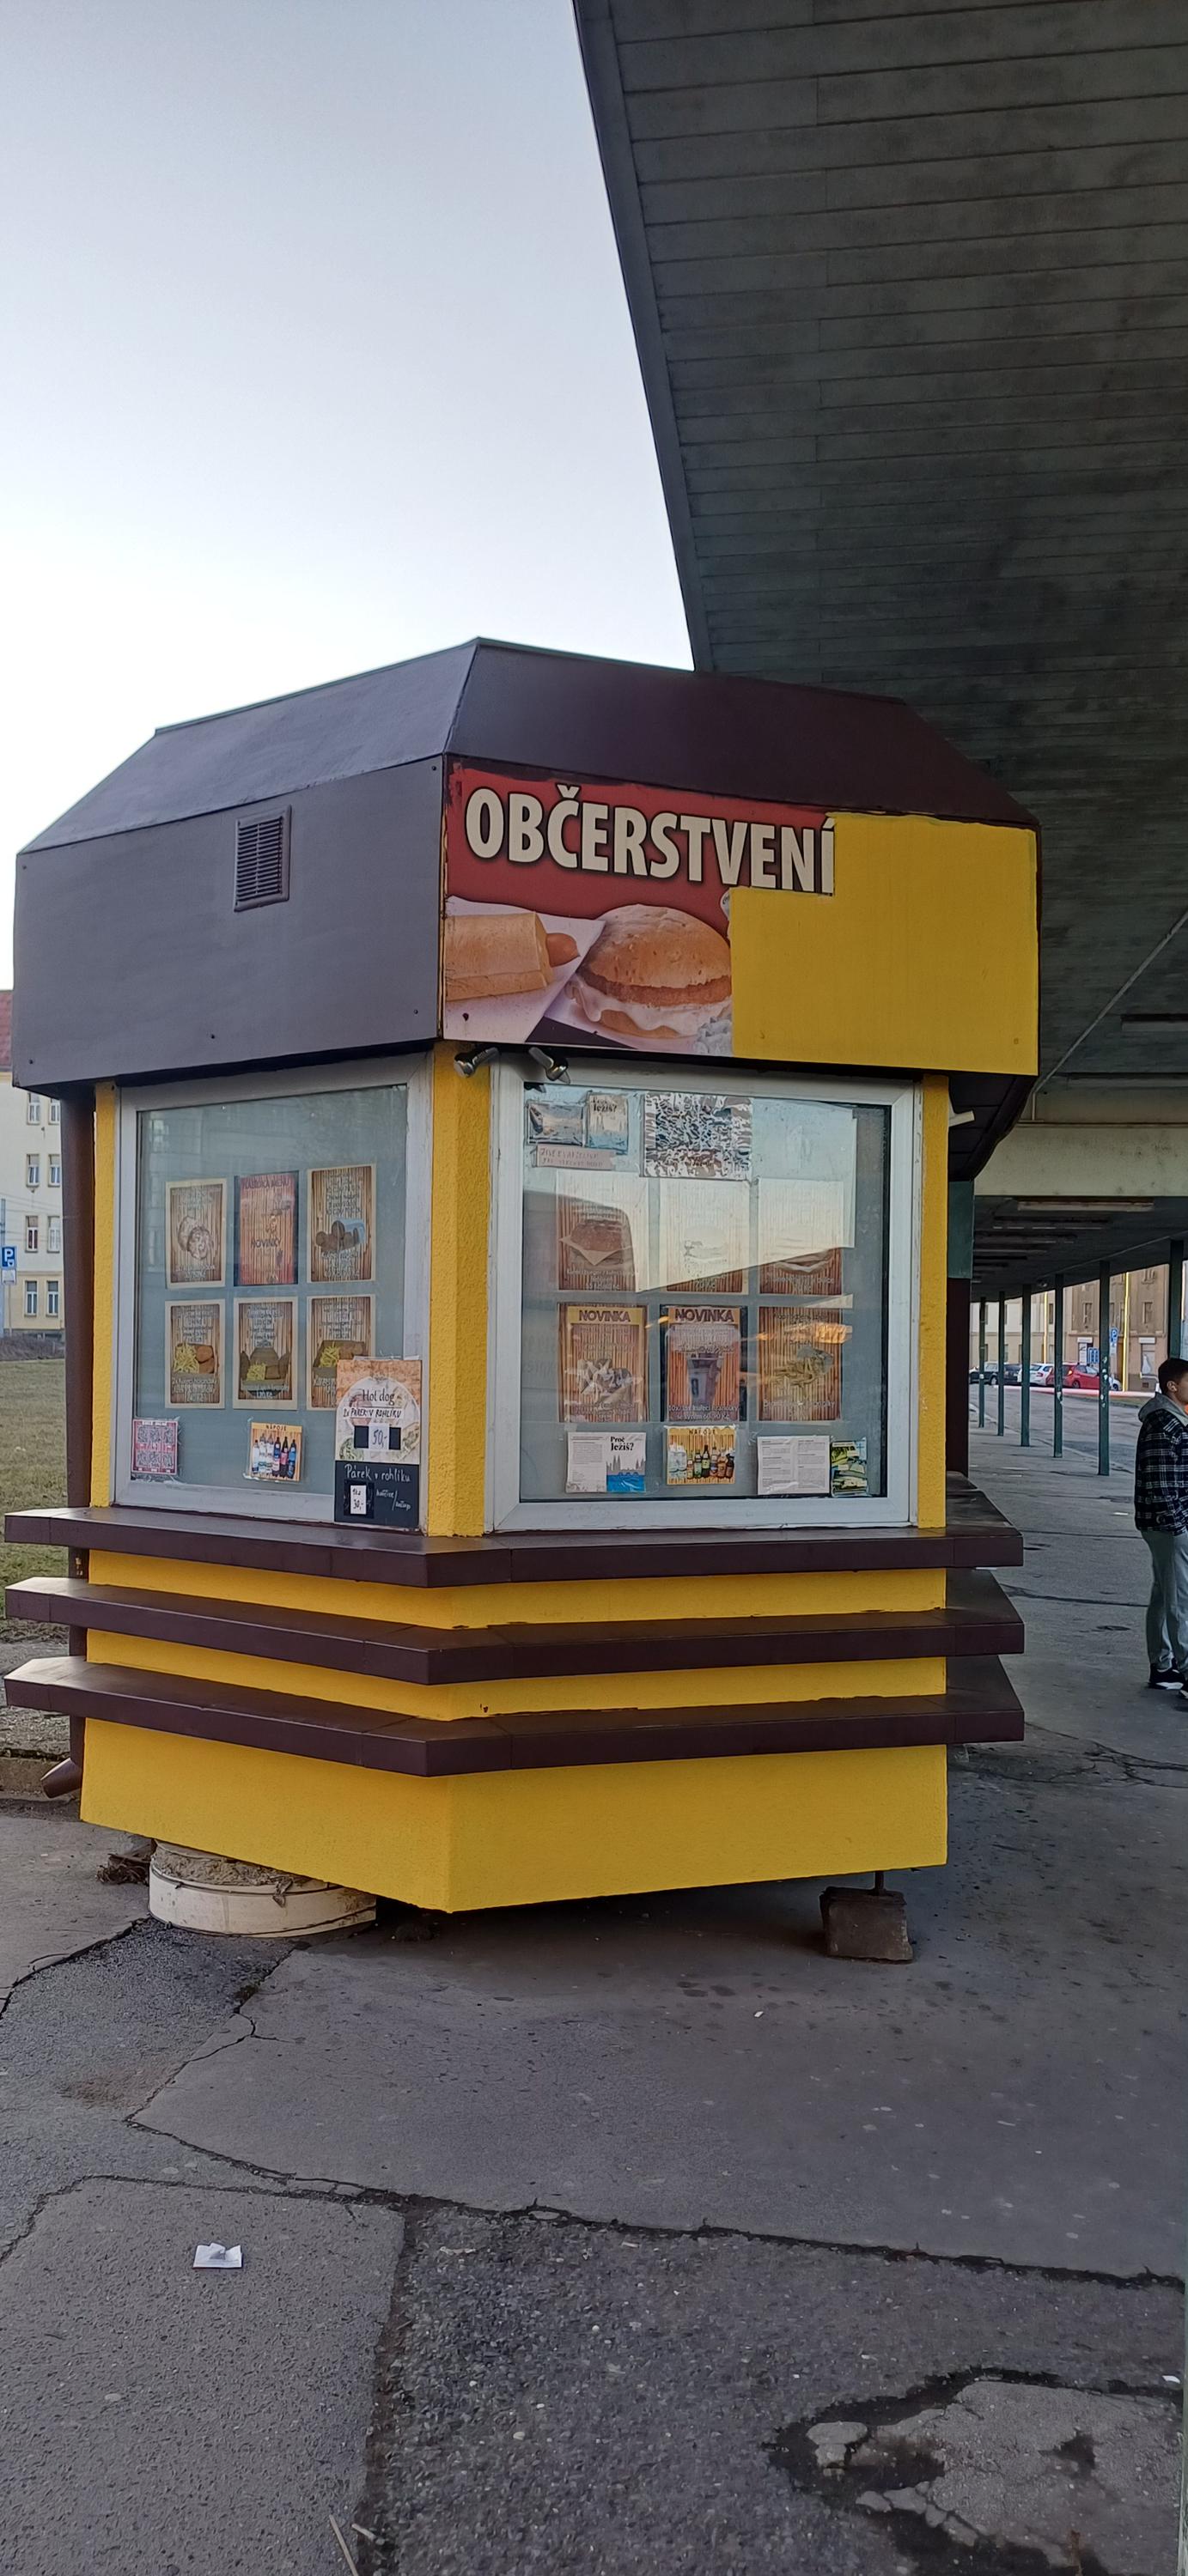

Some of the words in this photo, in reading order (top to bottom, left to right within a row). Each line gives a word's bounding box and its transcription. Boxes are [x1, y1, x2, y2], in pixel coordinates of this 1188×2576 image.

[465, 784, 835, 894] OBČERSTVENÍ
[579, 1309, 631, 1322] NOVINKA
[674, 1309, 734, 1322] NOVINKA
[362, 1389, 377, 1401] Hot
[379, 1388, 395, 1406] dog
[344, 1463, 372, 1480] Párek
